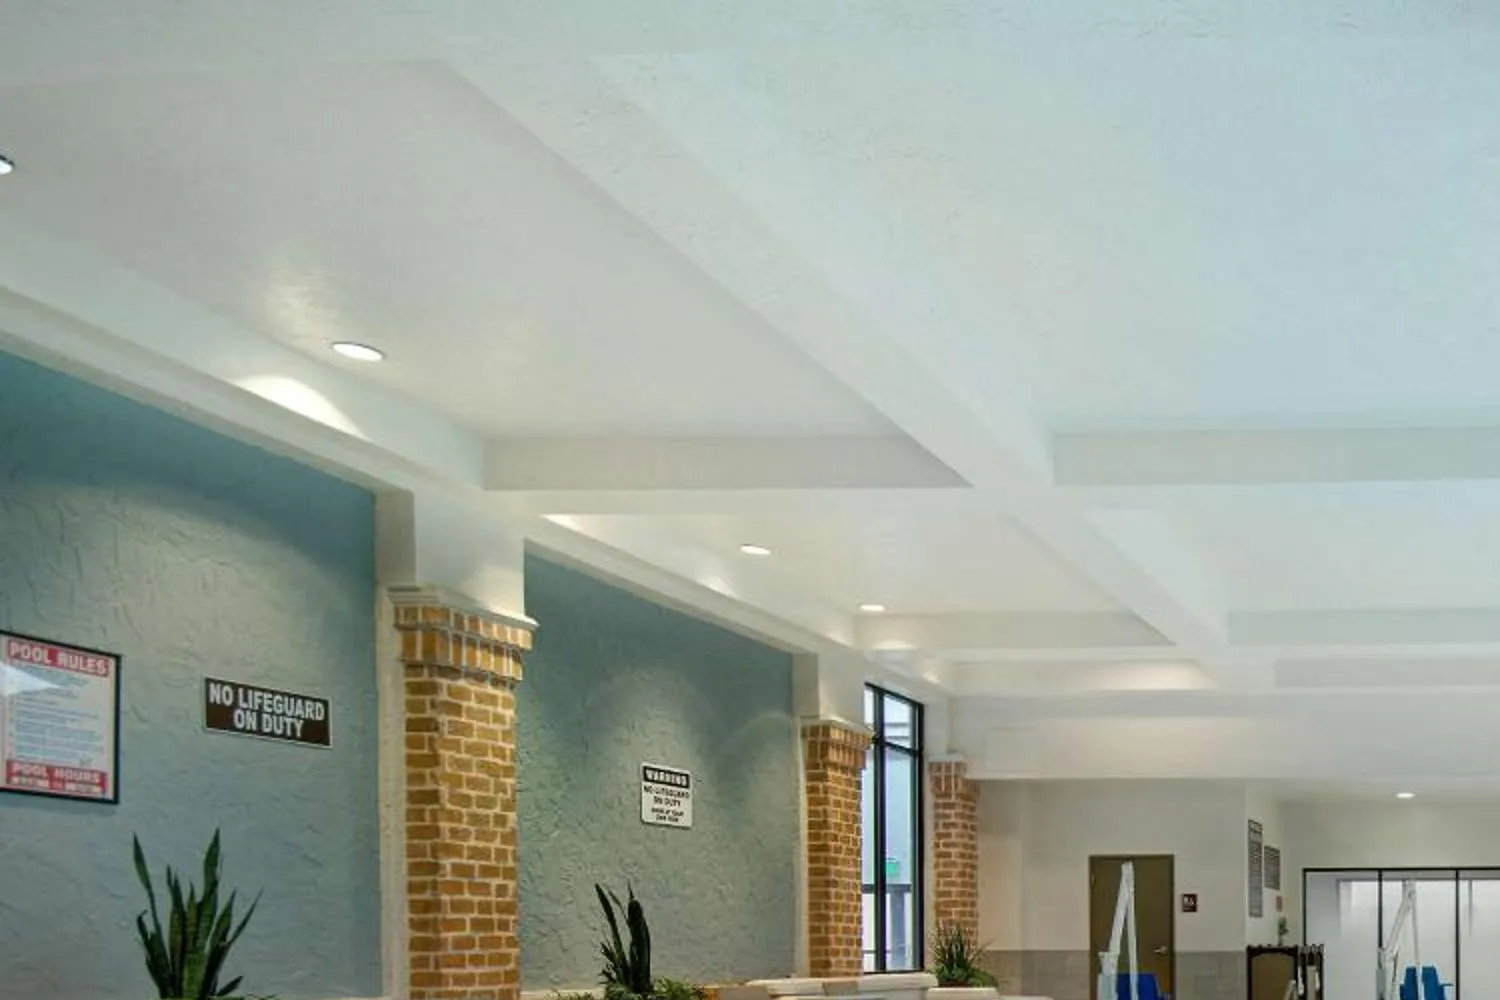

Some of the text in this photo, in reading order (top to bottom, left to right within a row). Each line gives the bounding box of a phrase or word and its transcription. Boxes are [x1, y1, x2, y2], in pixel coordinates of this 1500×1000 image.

[9, 640, 107, 675] POOL RULES
[209, 682, 325, 720] NO LIFEGUARD
[233, 708, 304, 737] ON DUTY
